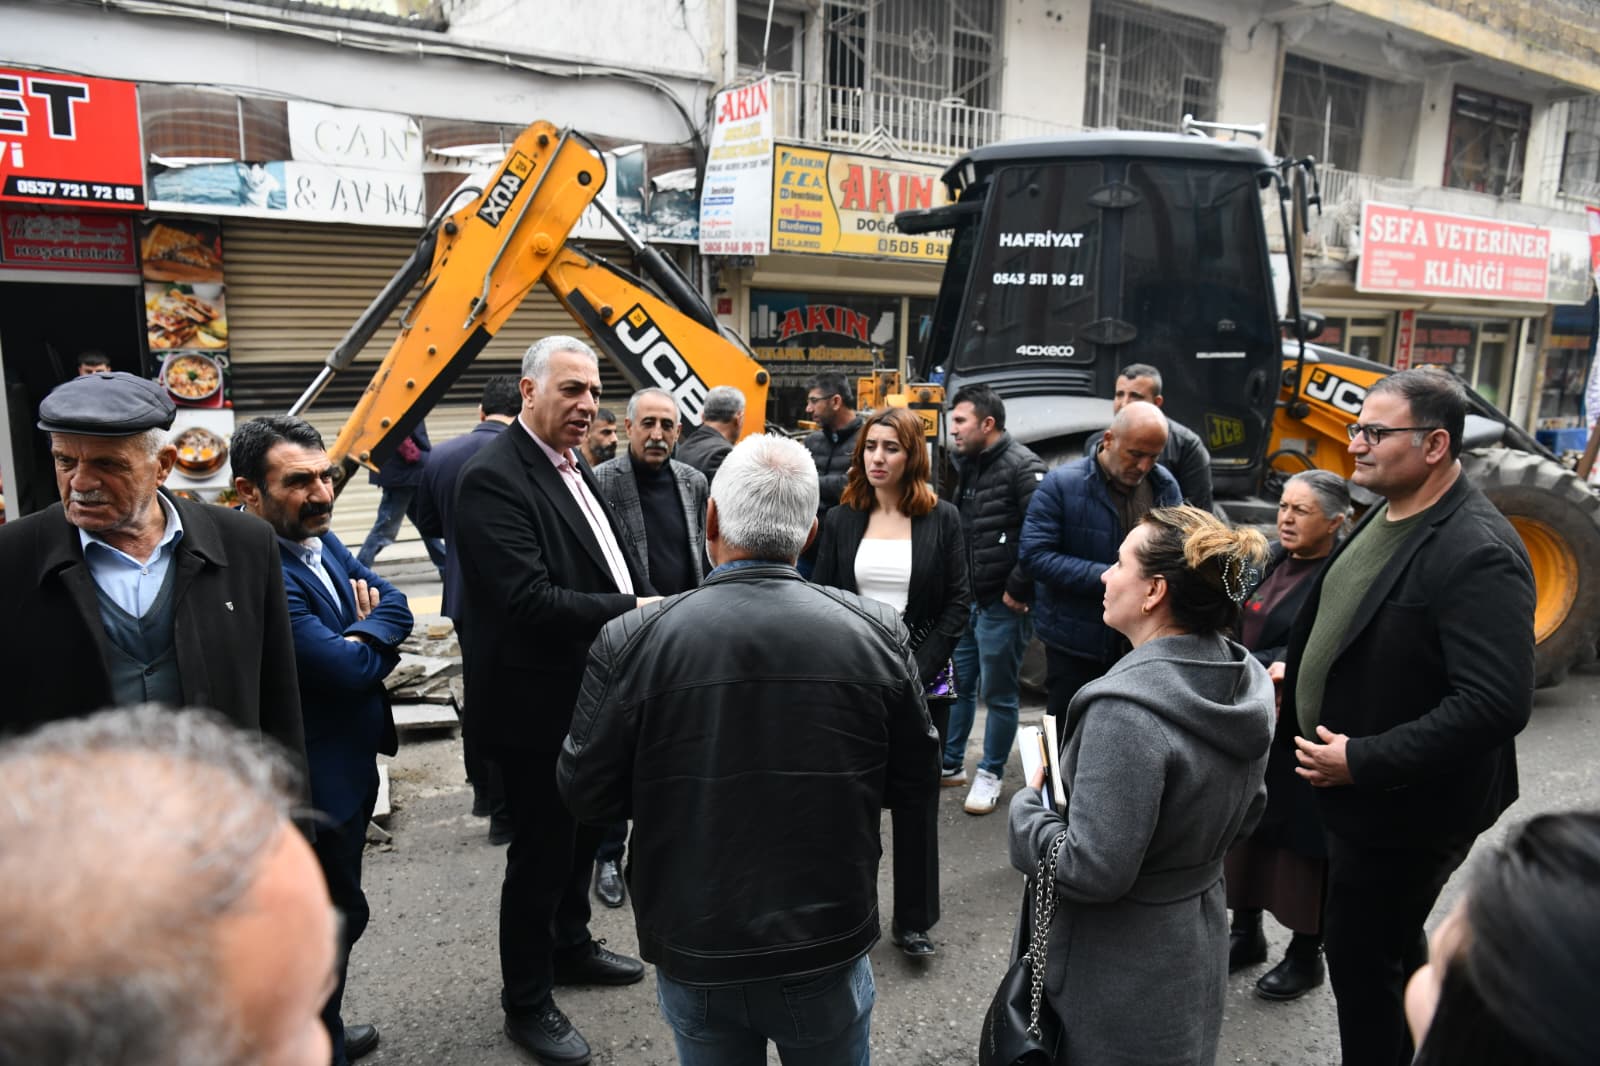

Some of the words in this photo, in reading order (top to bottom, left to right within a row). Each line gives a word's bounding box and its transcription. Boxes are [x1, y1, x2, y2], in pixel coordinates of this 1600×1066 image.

[717, 80, 769, 124] AKIN
[314, 119, 409, 161] CAN
[16, 180, 57, 195] 0537
[60, 183, 88, 198] 721
[92, 185, 113, 199] 72
[839, 163, 936, 214] AKIN
[780, 221, 821, 234] Buderus
[1000, 230, 1084, 247] HAFRİYAT
[1368, 214, 1428, 246] SEFA
[1434, 220, 1547, 260] VETERİNER
[878, 239, 919, 254] 0505
[993, 273, 1025, 285] 0543
[1029, 273, 1048, 285] 511
[1051, 274, 1066, 286] 10
[1069, 274, 1084, 286] 21
[1424, 256, 1504, 290] KLİNİĞİ
[777, 304, 870, 345] AKIN
[1306, 376, 1367, 414] JC
[1209, 418, 1245, 446] JCB
